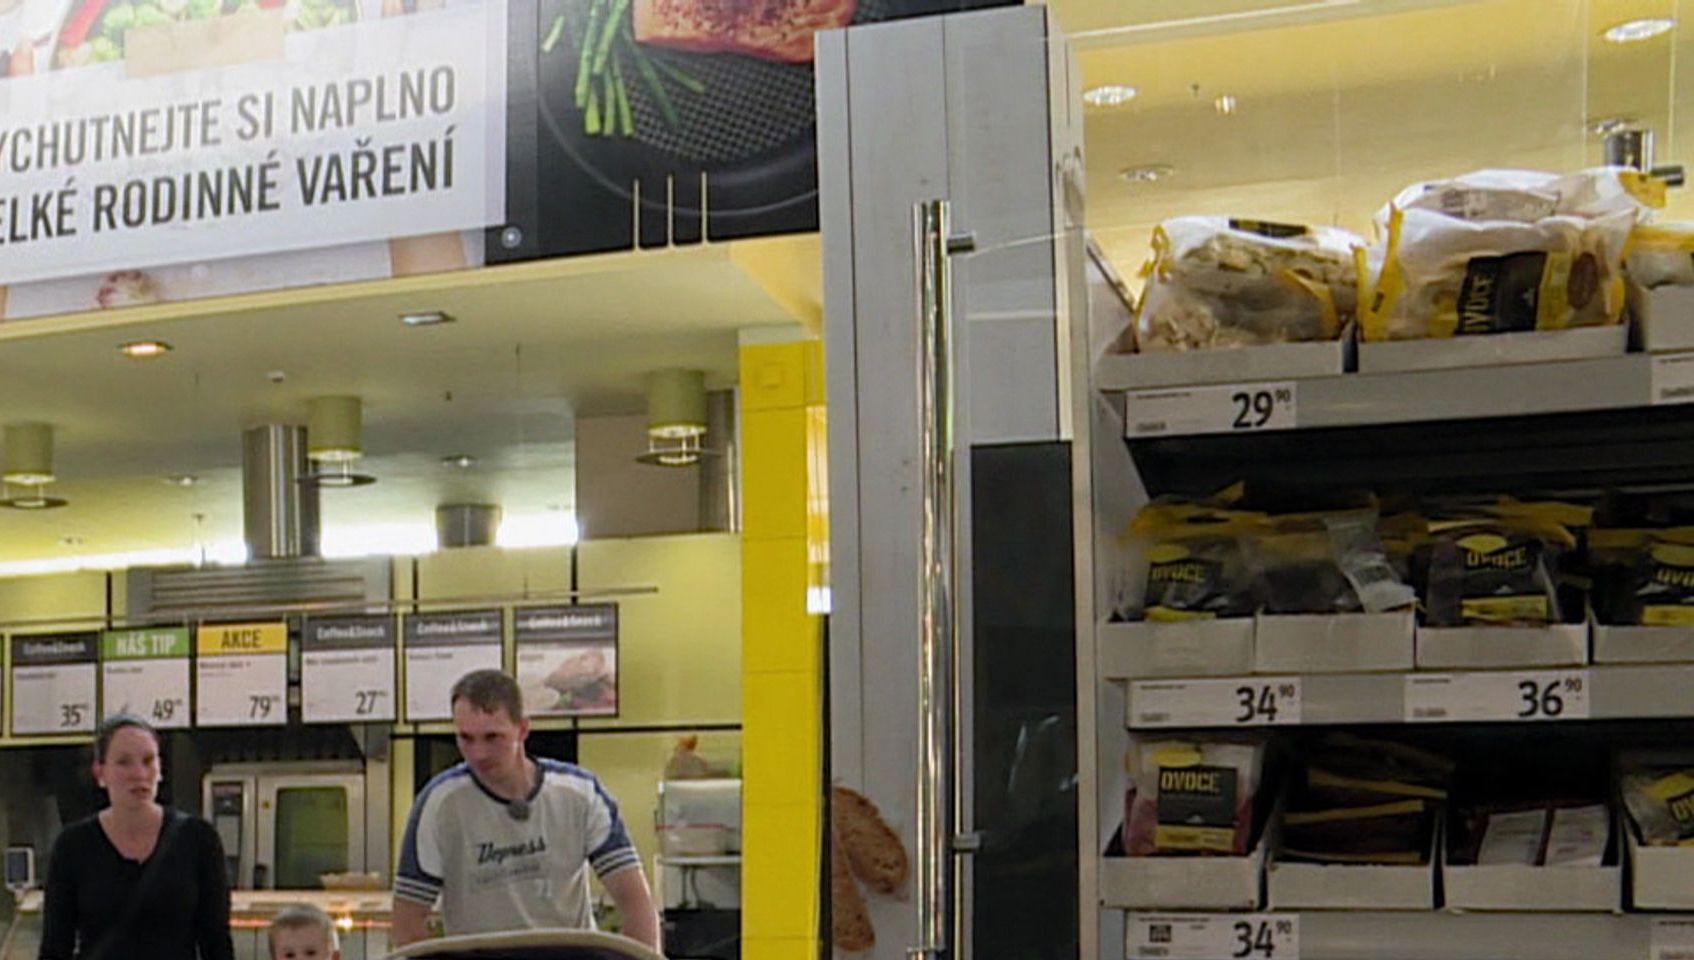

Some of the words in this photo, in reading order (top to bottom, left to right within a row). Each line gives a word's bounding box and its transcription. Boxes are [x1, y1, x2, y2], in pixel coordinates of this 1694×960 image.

[237, 91, 274, 141] SI
[290, 65, 457, 134] NAPLNO
[93, 158, 282, 233] RODINNÉ
[296, 126, 458, 207] VAŘENÍ
[1231, 391, 1274, 429] 29
[116, 631, 147, 656] NÁŠ
[151, 634, 177, 654] TIP
[220, 629, 263, 649] AKCE
[249, 696, 271, 718] 79
[355, 690, 377, 715] 27
[1235, 686, 1278, 723] 34
[1518, 679, 1564, 717] 36
[1565, 677, 1582, 693] 90
[60, 703, 81, 727] 35
[152, 700, 174, 720] 49
[1160, 770, 1221, 793] OVOCE
[1233, 921, 1275, 958] 34
